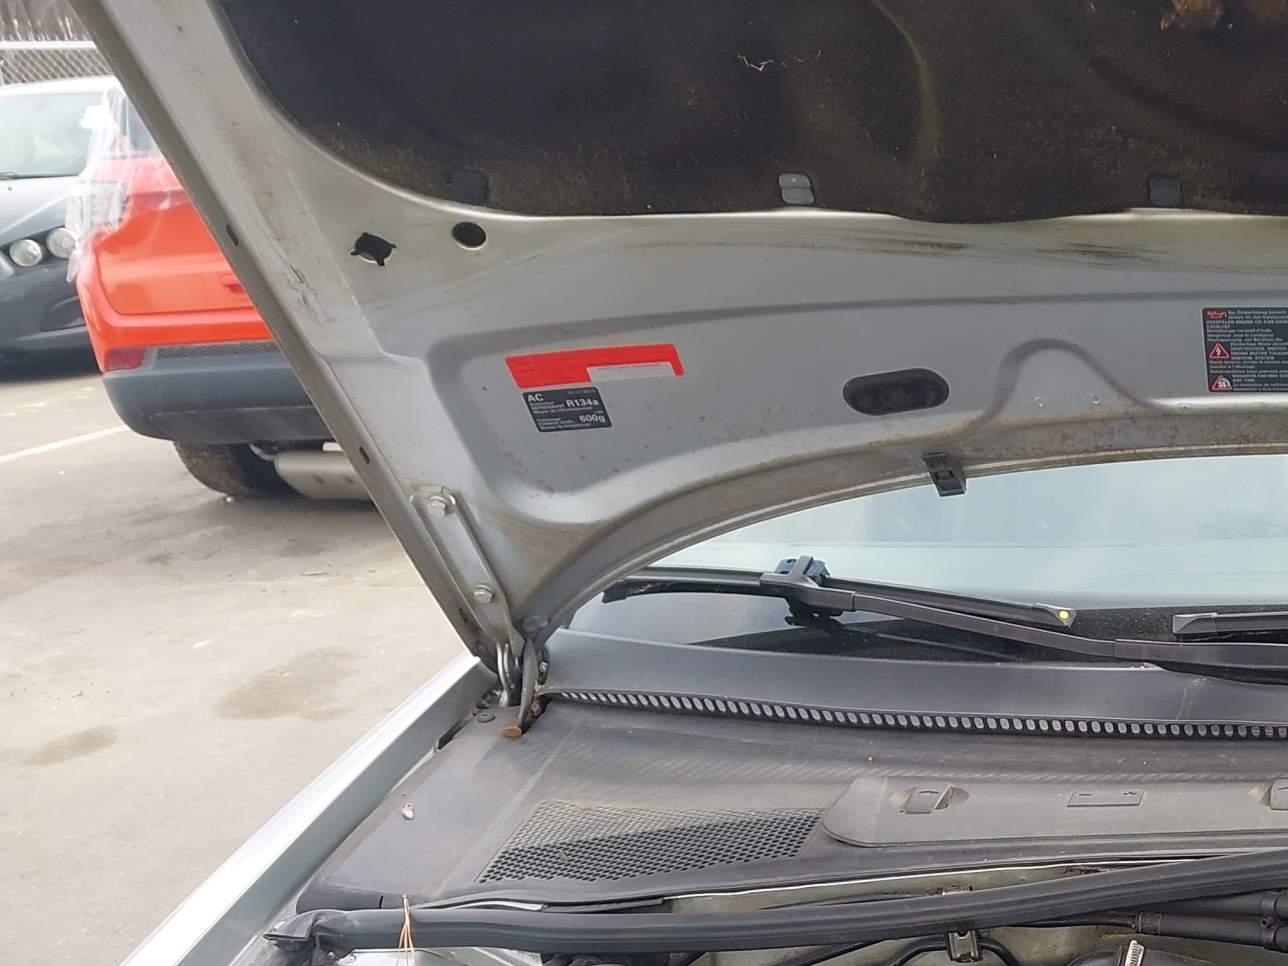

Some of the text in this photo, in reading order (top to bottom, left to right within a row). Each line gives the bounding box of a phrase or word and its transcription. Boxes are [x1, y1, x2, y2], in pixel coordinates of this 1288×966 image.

[527, 393, 544, 402] AC
[565, 398, 599, 408] R134a
[579, 414, 606, 423] 600g
